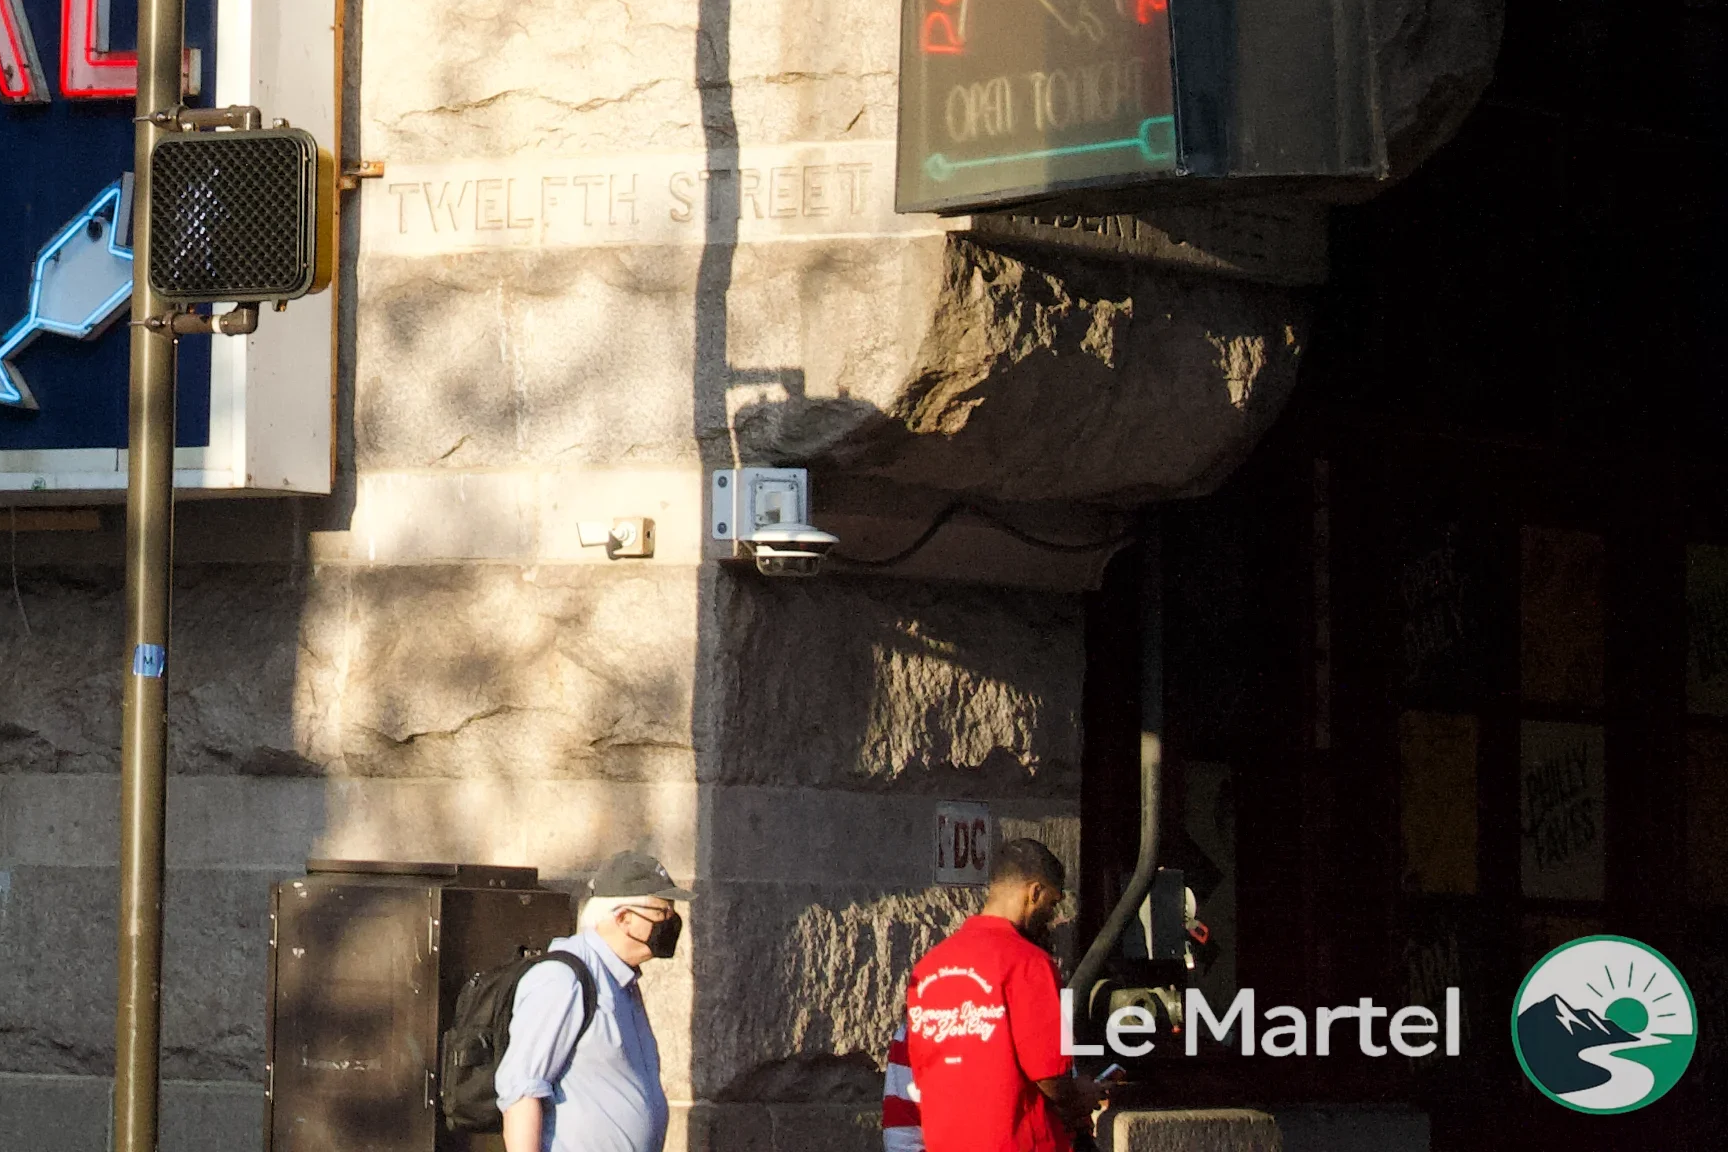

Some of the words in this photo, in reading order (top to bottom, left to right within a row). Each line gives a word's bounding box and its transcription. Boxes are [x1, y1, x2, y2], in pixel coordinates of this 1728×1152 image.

[945, 75, 1013, 142] OPEN
[388, 172, 640, 235] TWELFTH
[669, 162, 873, 224] STREET
